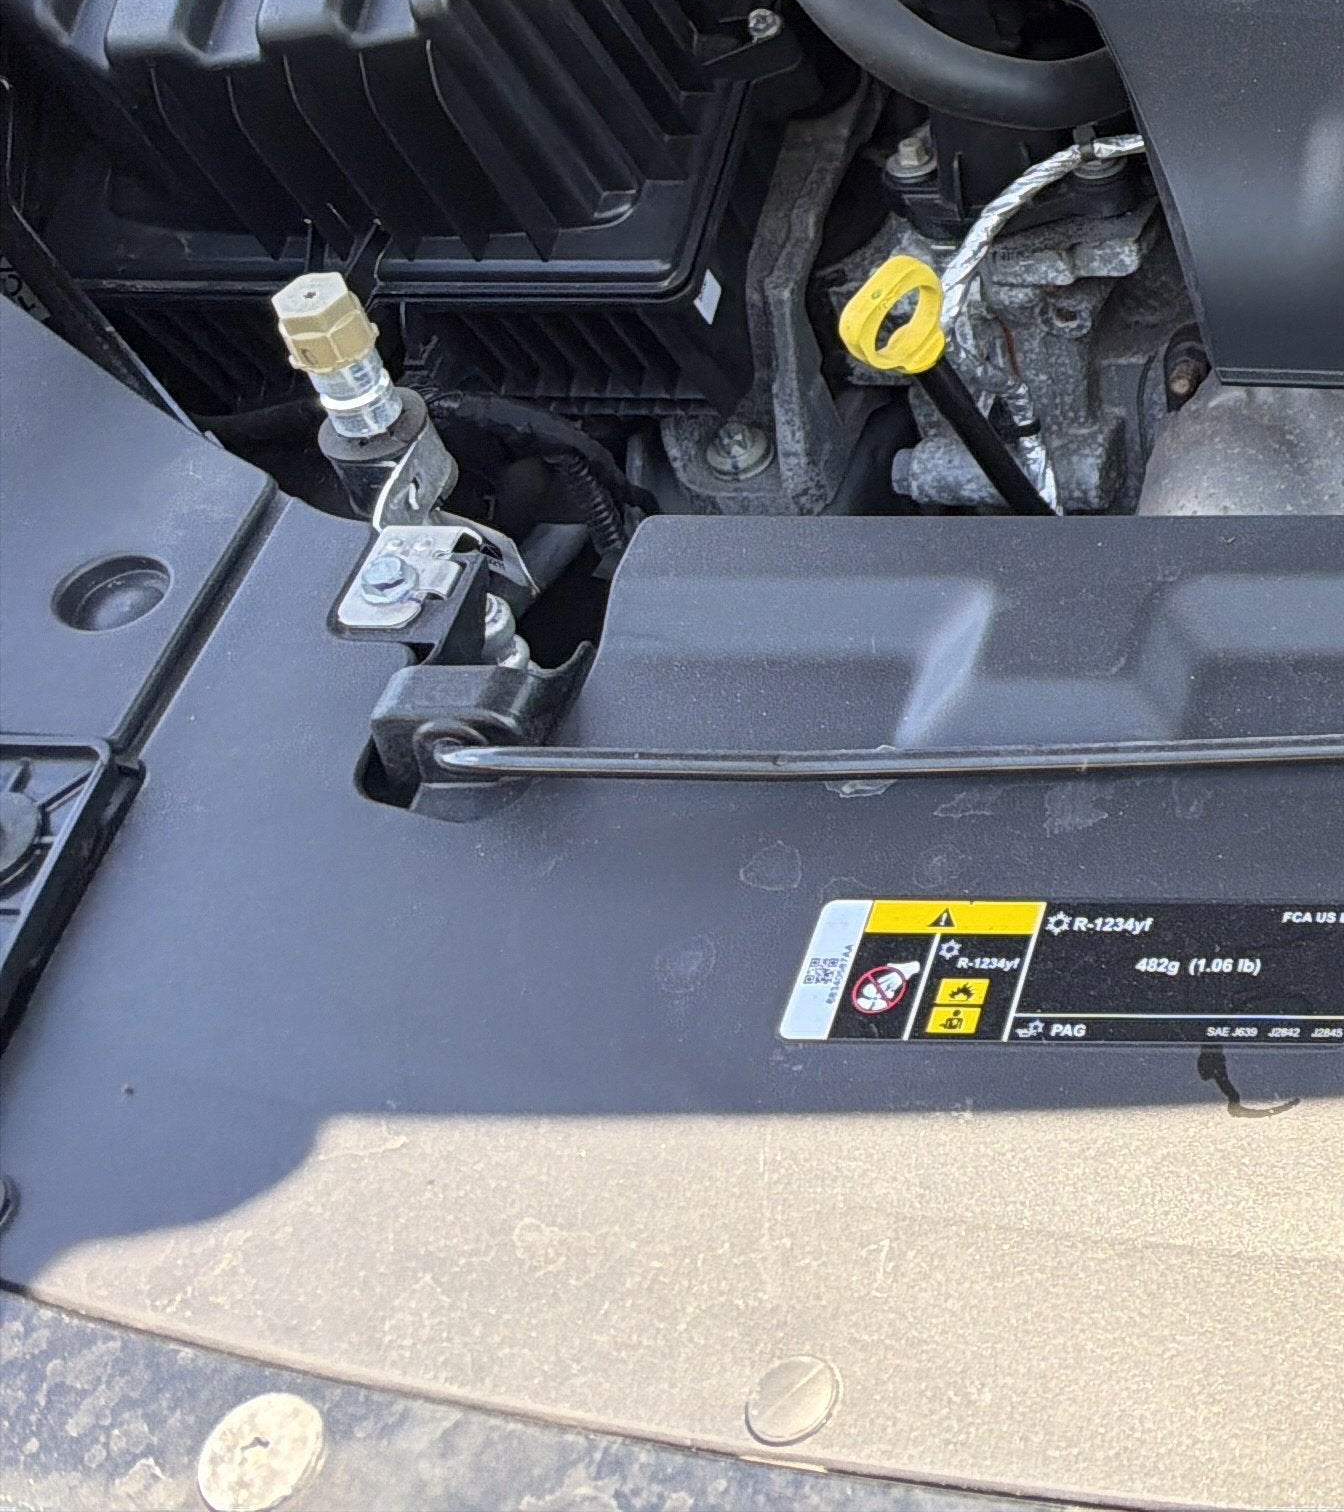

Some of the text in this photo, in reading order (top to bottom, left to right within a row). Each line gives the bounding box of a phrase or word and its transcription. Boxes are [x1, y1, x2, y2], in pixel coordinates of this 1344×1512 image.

[1073, 916, 1154, 936] R-1234yf
[1281, 911, 1313, 924] FCA
[1316, 912, 1337, 924] US
[956, 957, 1021, 972] R-1234yf
[1135, 958, 1262, 976] 482g (1.06 lb)
[1051, 1024, 1087, 1037] PAG
[1205, 1026, 1231, 1038] SAE
[1231, 1026, 1259, 1038] J639
